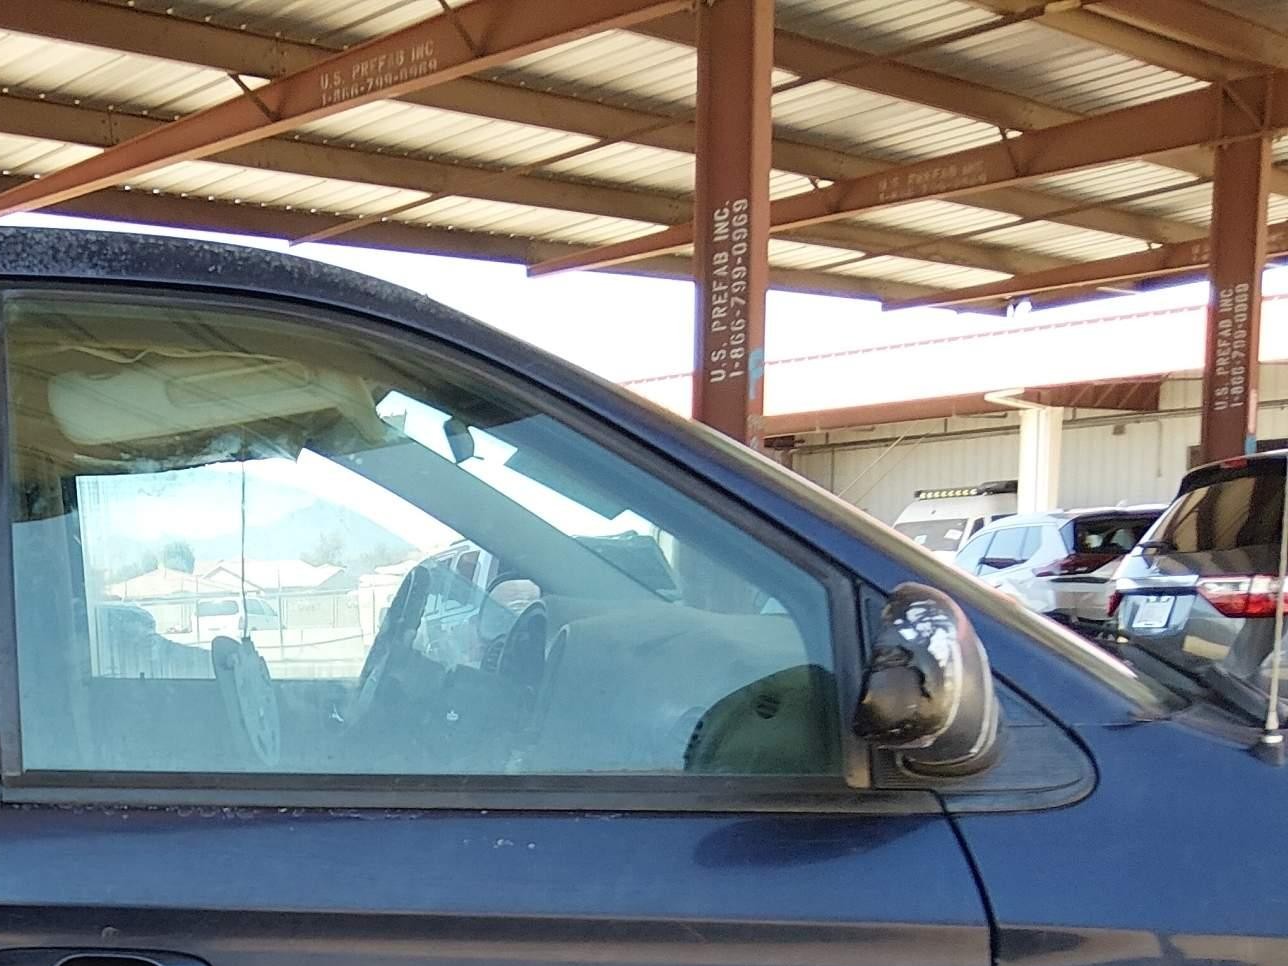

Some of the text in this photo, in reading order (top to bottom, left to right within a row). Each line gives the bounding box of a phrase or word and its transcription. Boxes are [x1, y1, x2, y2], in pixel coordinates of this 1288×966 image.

[710, 200, 730, 383] U.S. PREFAB INC.
[729, 198, 749, 378] 1-866-799-0969
